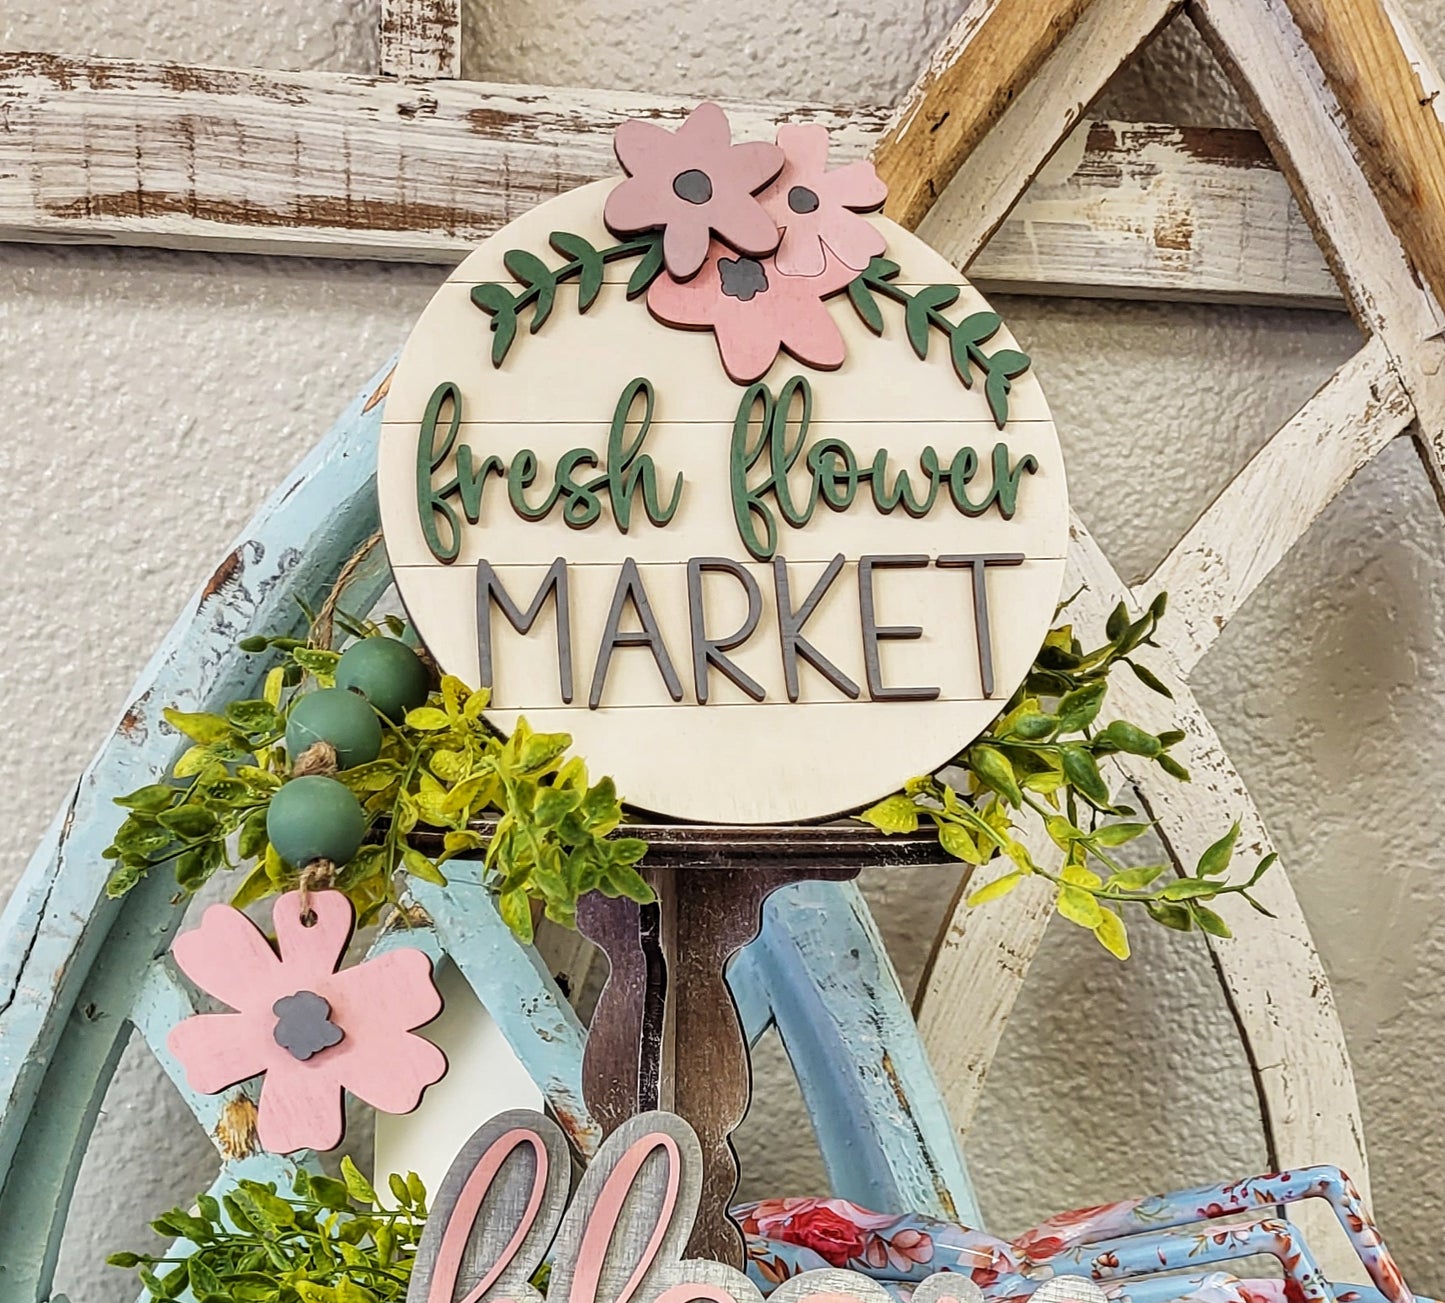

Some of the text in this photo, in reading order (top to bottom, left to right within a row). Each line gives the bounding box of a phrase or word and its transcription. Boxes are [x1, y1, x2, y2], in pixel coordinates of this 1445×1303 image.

[417, 375, 1039, 564] fresh flower
[476, 553, 1026, 709] MARKET
